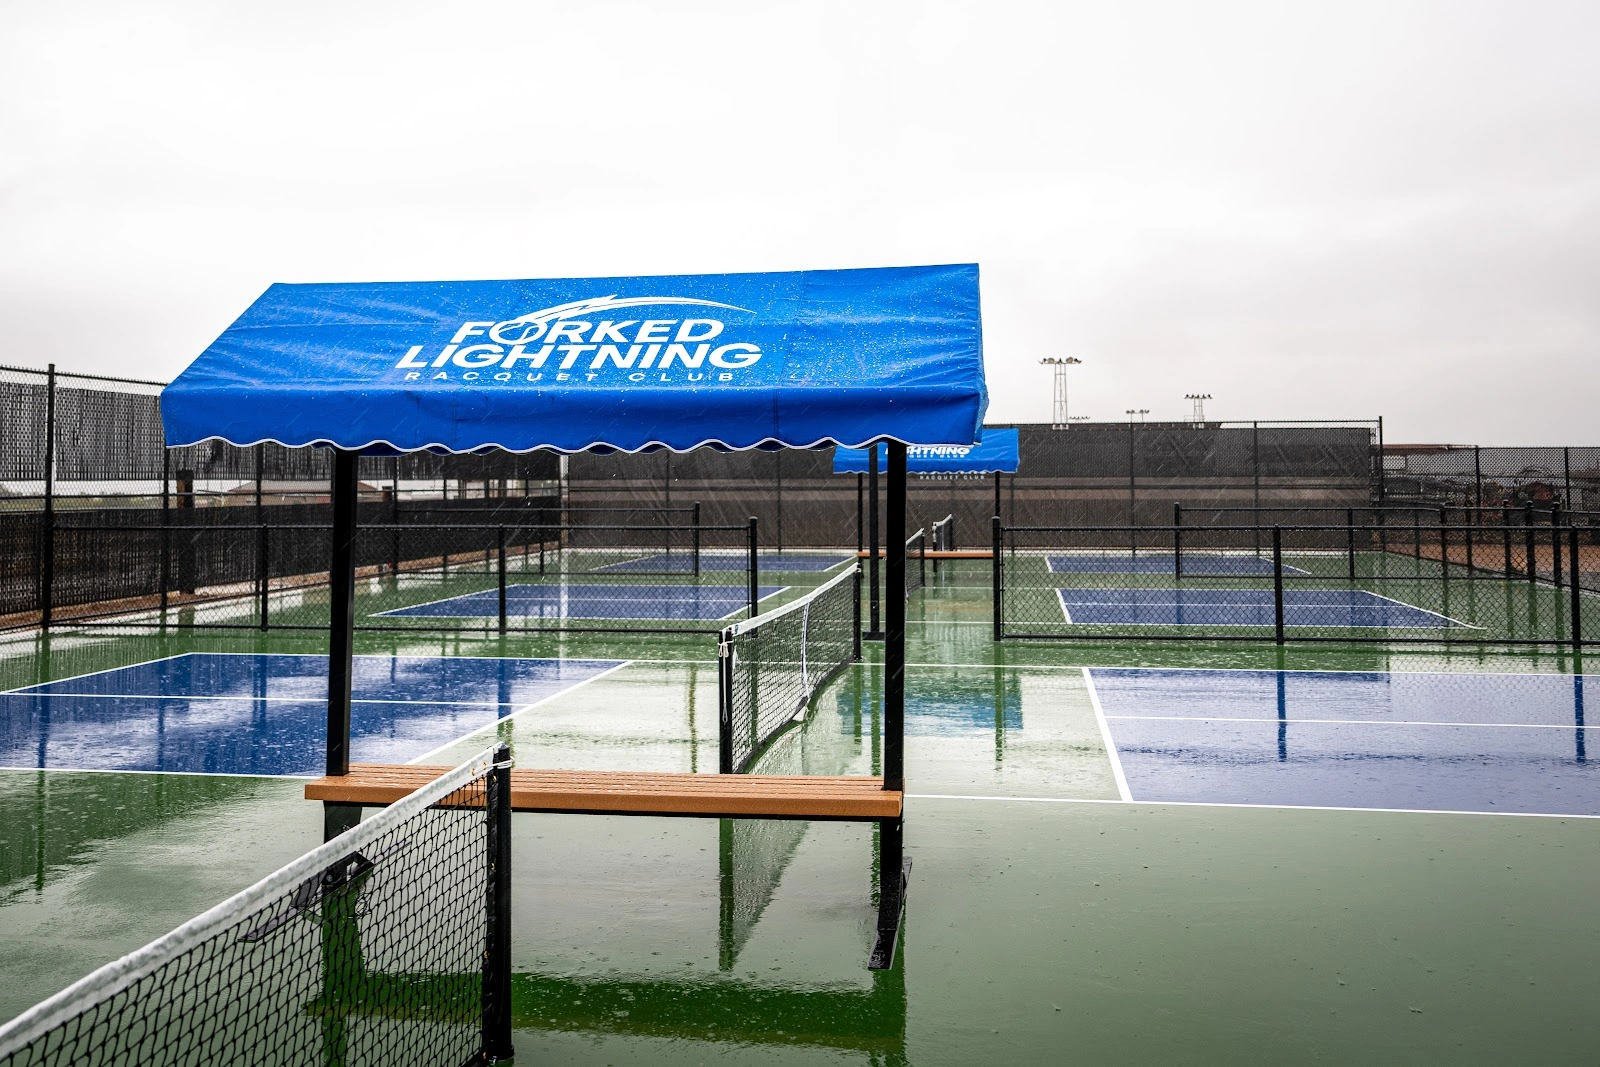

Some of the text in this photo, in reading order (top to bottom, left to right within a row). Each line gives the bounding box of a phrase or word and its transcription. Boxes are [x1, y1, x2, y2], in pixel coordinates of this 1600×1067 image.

[450, 319, 724, 345] FORKED
[395, 342, 763, 369] LIGHTNING
[404, 371, 734, 382] RACQUET CLUB
